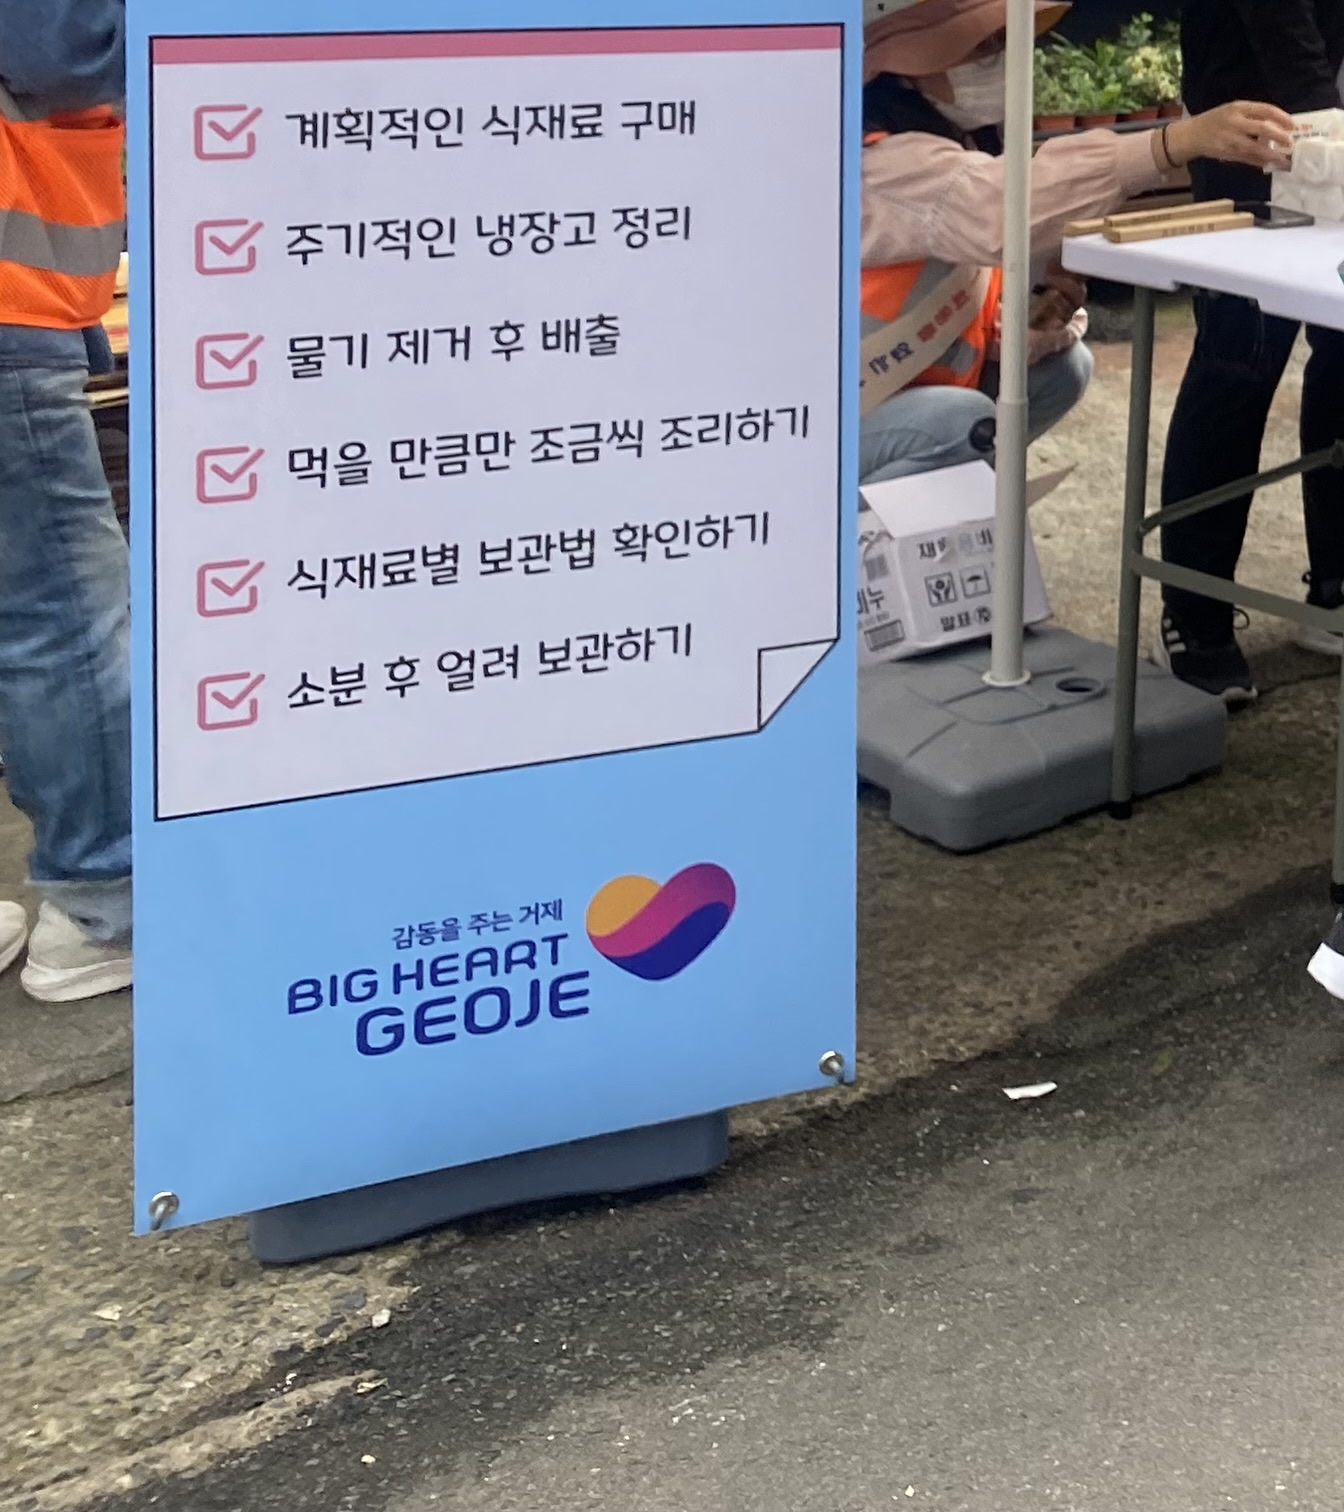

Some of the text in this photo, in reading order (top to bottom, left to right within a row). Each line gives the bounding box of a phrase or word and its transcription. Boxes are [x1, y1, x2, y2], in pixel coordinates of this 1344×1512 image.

[285, 98, 697, 153] 계획적인 식재료 구매
[285, 205, 693, 265] 주기적인 냉장고 정리
[286, 313, 622, 381] 물기 제거 후 배출
[287, 404, 812, 491] 먹을 만큼만 조금씩 조리하기
[287, 509, 772, 599] 식재료별 보관법 확인하기
[287, 622, 695, 713] 소분 후 얼려 보관하기
[392, 898, 565, 951] 감동을 주는 거제
[287, 932, 570, 1016] BIG HEART
[355, 970, 592, 1056] GEOJE
